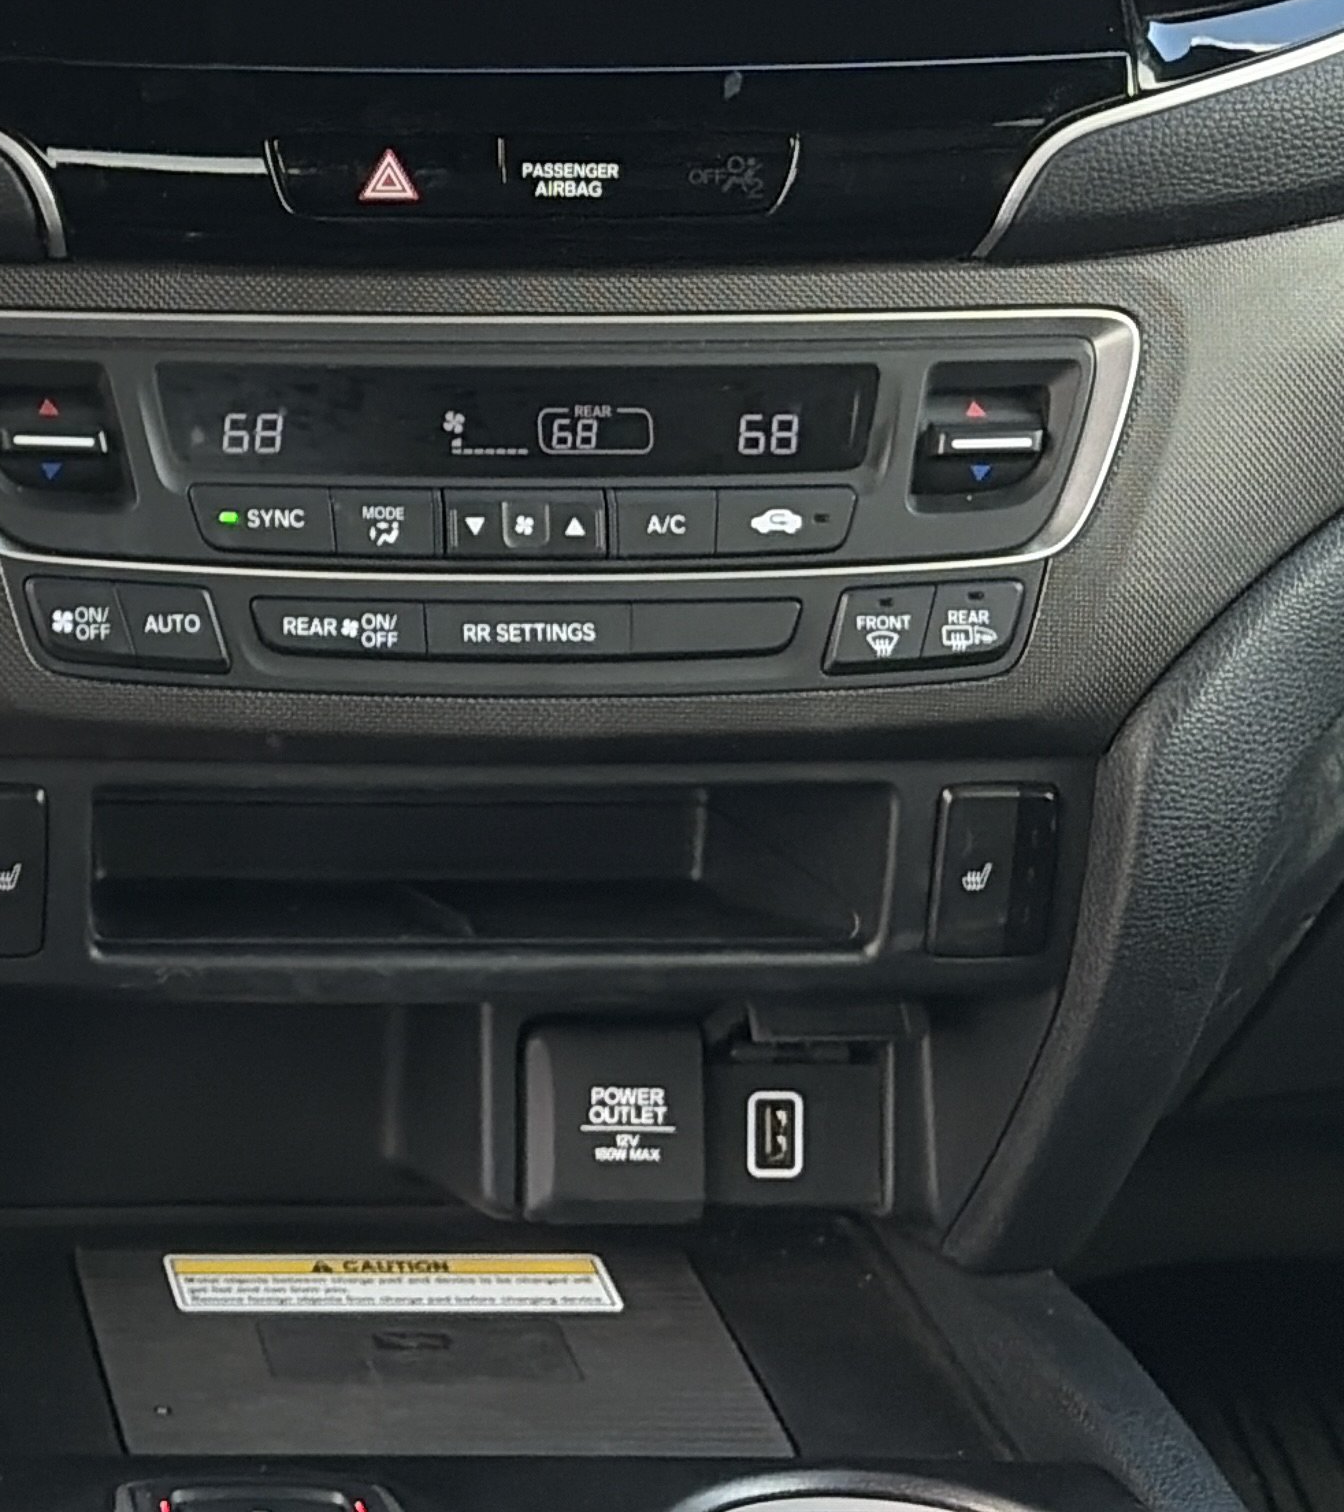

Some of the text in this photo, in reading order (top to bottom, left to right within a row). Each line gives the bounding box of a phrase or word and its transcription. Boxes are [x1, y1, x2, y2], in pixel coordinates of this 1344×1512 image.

[521, 162, 620, 179] PASSENGER
[534, 181, 603, 197] AIRBAG
[574, 405, 611, 418] REAR
[222, 412, 284, 454] 68
[552, 418, 598, 450] 68
[737, 413, 799, 455] 68
[247, 508, 305, 529] SYNC
[361, 506, 405, 521] MODE
[646, 514, 687, 535] A/C
[74, 605, 110, 624] ON/
[144, 614, 202, 634] AUTO
[361, 612, 398, 631] ON/
[855, 615, 912, 632] FRONT
[947, 609, 990, 625] REAR
[75, 624, 111, 642] OFF
[282, 616, 337, 637] REAR
[462, 622, 596, 644] RR SETTINGS
[361, 631, 399, 649] OFF
[590, 1086, 665, 1106] POWER
[588, 1106, 668, 1125] OUTLET
[629, 1148, 661, 1162] MAX
[342, 1259, 450, 1274] CAUTION
